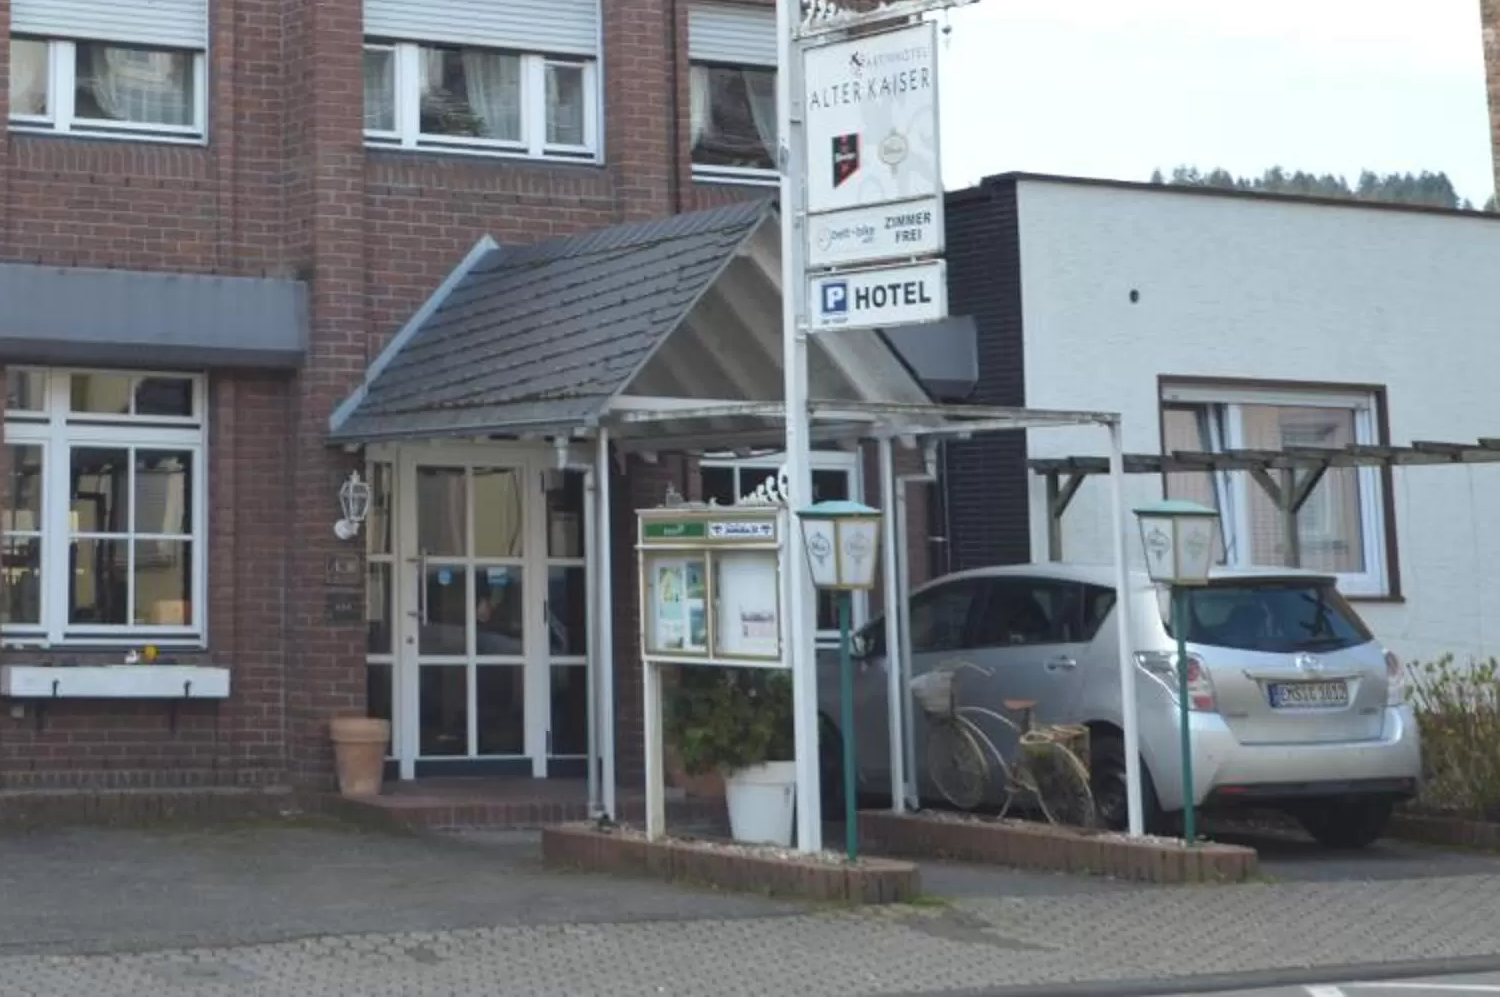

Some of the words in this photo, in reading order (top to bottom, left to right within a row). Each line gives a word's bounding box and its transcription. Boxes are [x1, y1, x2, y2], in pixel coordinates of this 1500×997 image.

[810, 80, 862, 111] ALTER
[867, 66, 931, 101] KAISER
[883, 210, 932, 230] ZIMMER
[895, 228, 922, 244] FREI
[854, 280, 932, 310] HOTEL
